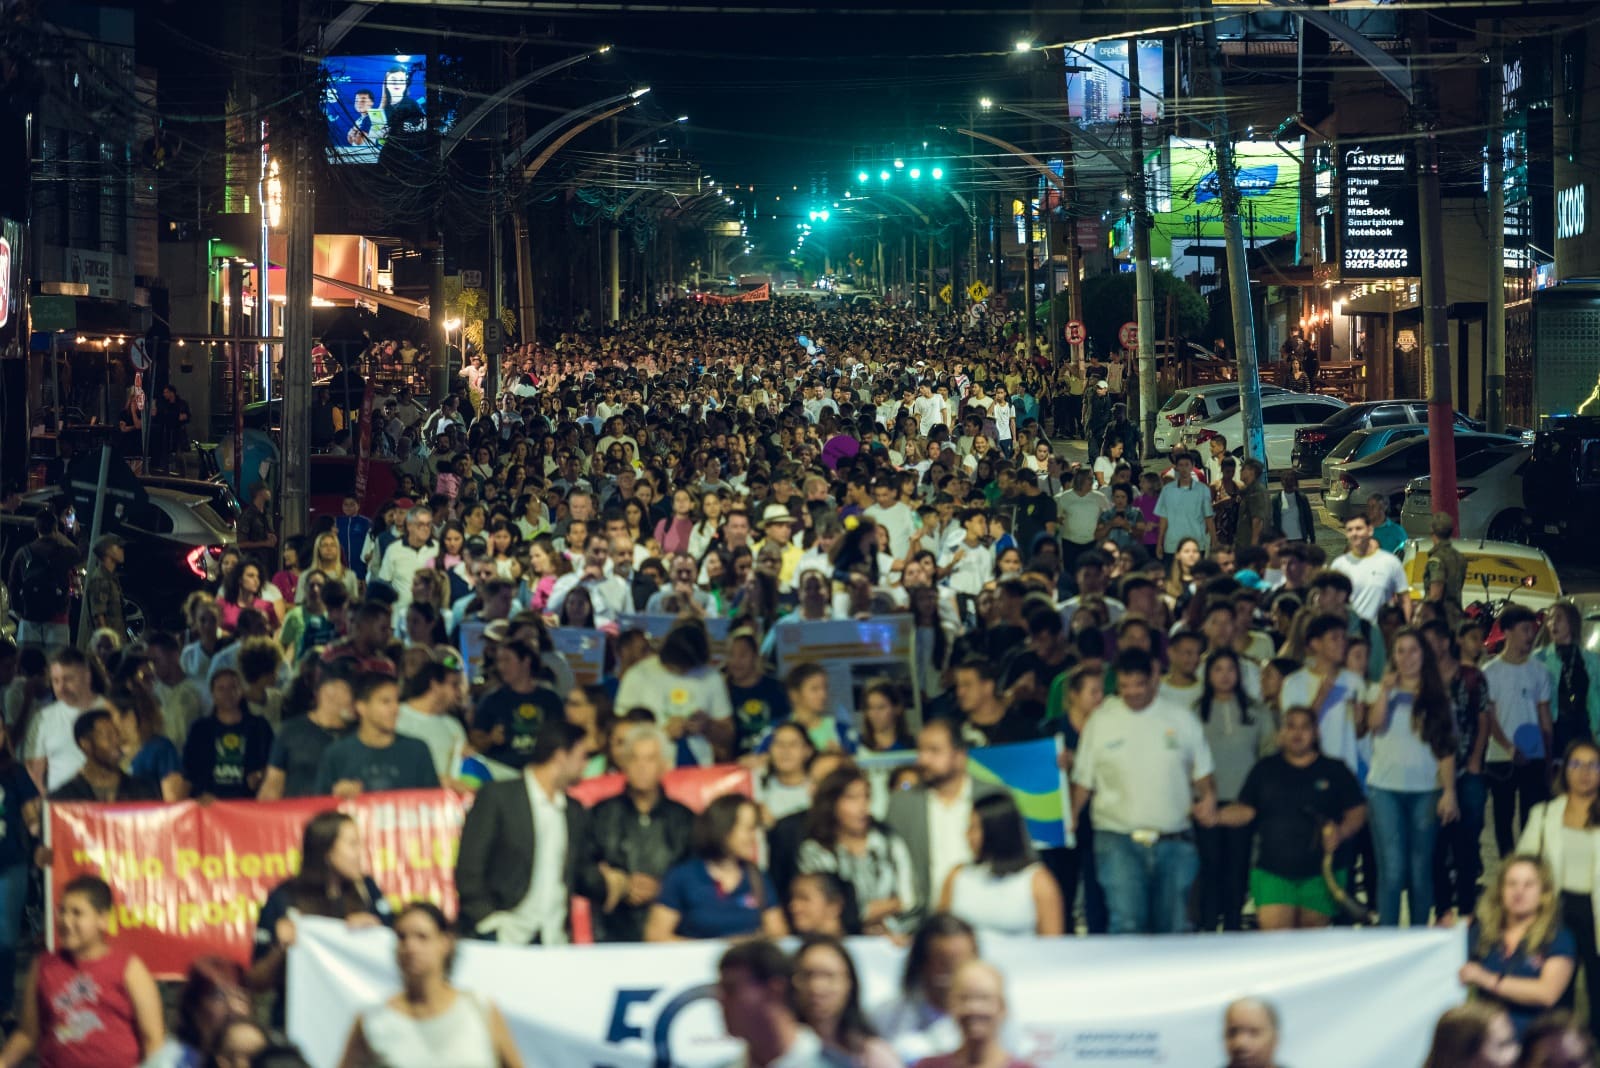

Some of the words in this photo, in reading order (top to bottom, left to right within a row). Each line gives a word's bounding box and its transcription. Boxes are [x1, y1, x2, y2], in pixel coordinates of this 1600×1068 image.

[1347, 178, 1379, 186] iPhone
[1347, 198, 1370, 206] iMac
[1347, 208, 1391, 216] MacBook
[1557, 183, 1585, 240] SICOOB
[1347, 218, 1404, 228] Smartphone
[1347, 228, 1393, 237] Notebook
[1345, 249, 1408, 259] 3702-3772
